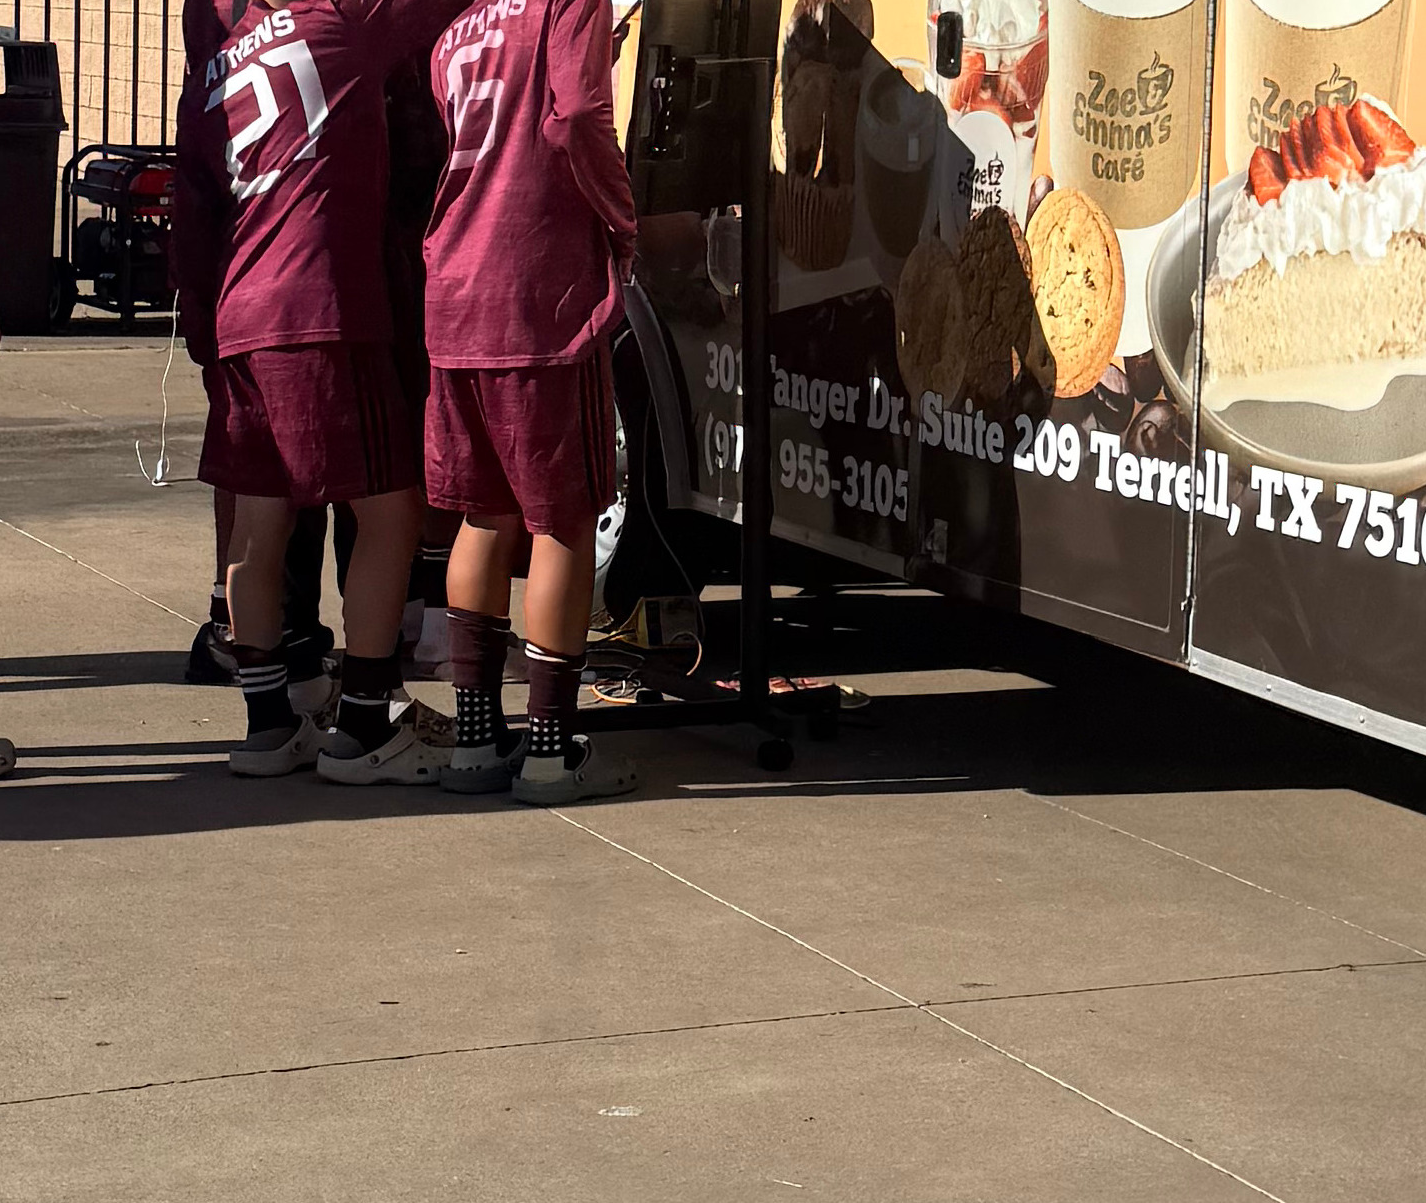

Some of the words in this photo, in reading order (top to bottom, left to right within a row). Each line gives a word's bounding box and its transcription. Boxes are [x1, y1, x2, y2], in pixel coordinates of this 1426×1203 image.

[204, 8, 296, 89] ATHENS
[204, 39, 330, 204] 21
[1072, 91, 1173, 151] Emma's
[1087, 69, 1138, 118] Zoe
[770, 354, 861, 429] anger
[866, 376, 911, 437] Dr.
[919, 389, 1005, 465] Suite
[1013, 414, 1081, 482] 209
[1089, 428, 1242, 537] Terrell,
[1250, 465, 1324, 544] TX
[779, 438, 909, 522] 955-3105
